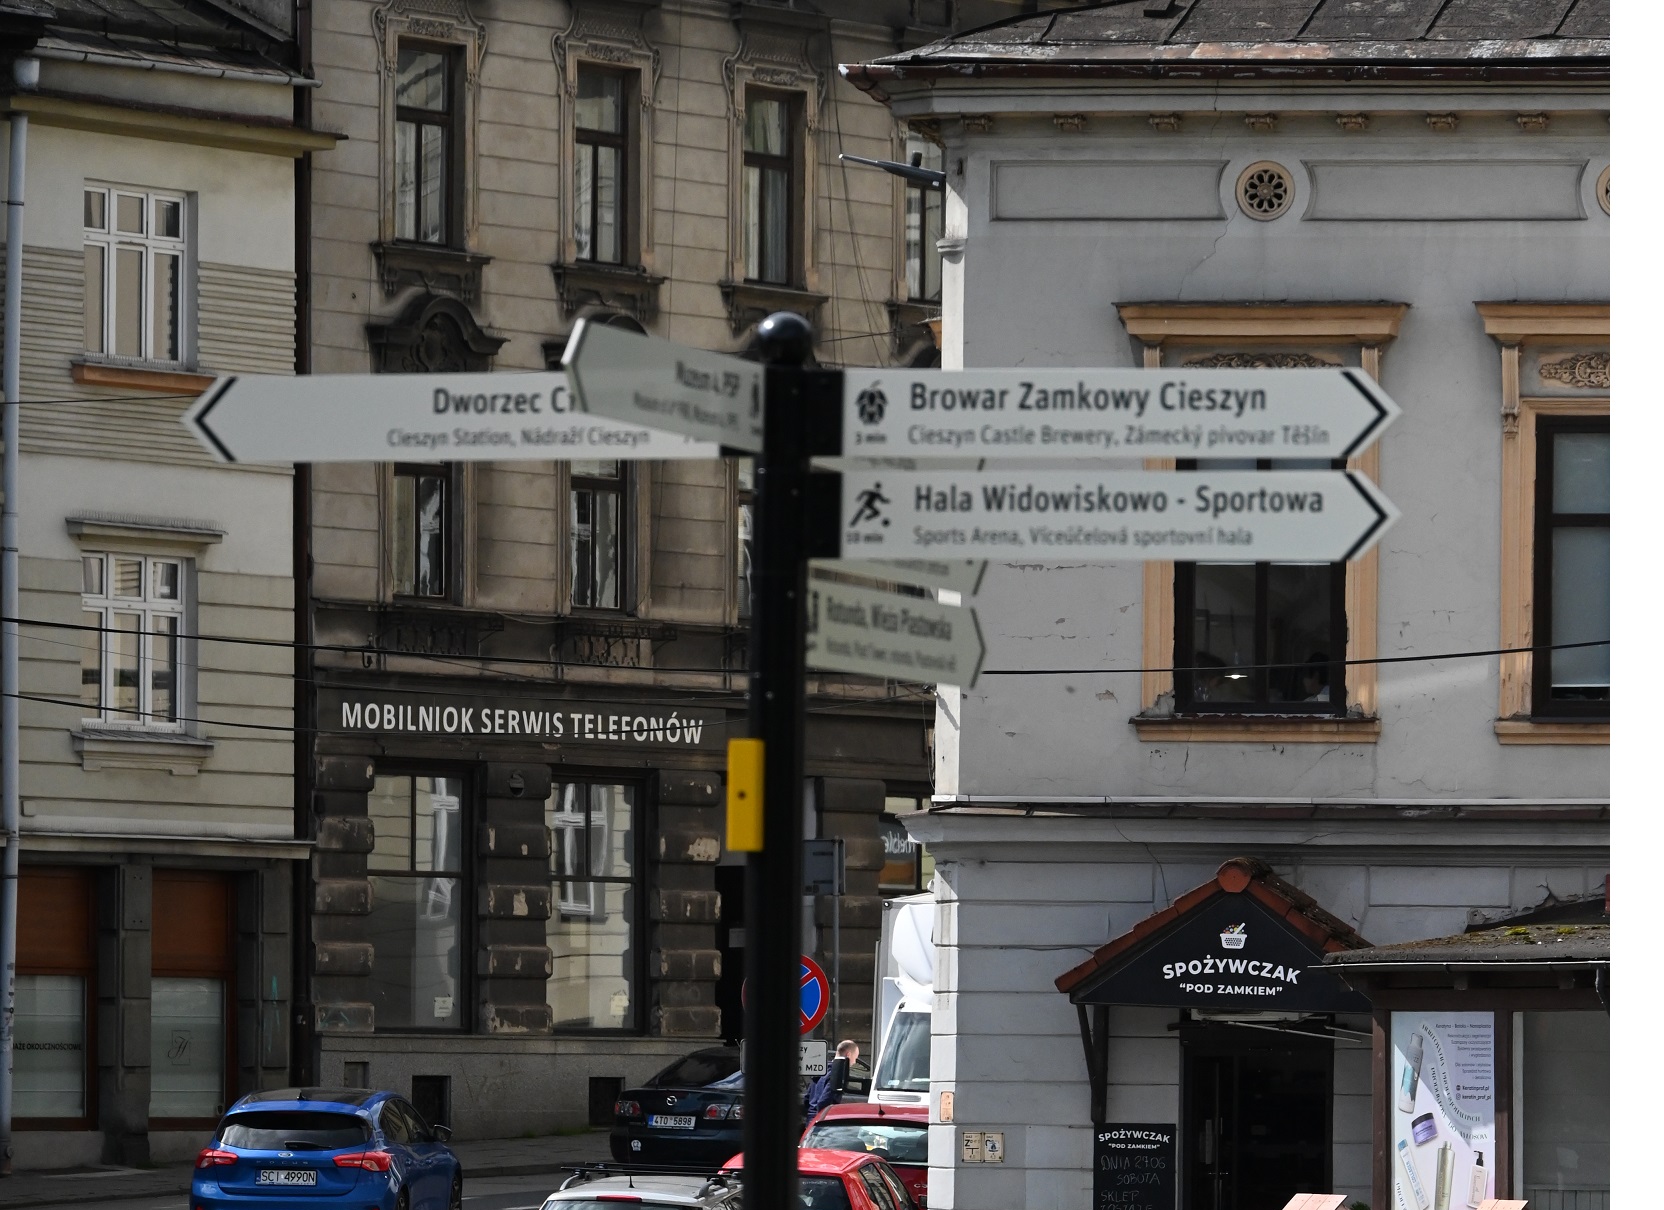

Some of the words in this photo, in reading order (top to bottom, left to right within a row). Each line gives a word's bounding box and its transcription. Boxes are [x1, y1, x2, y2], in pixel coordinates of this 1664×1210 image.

[432, 387, 542, 414] Dworzec
[910, 381, 1010, 411] Browar
[1017, 380, 1151, 418] Zamkowy
[1160, 381, 1267, 418] Cieszyn
[386, 427, 449, 451] Cieszyn
[453, 427, 517, 449] Station,
[520, 426, 584, 447] Nádraží
[587, 427, 650, 451] Cieszyn
[908, 425, 976, 449] Cieszyn
[980, 425, 1036, 445] Castle
[1040, 425, 1119, 449] Brewery,
[1124, 425, 1201, 448] Zámecký
[1207, 427, 1276, 449] pivovar
[1281, 425, 1331, 445] Těšín
[914, 484, 973, 512] Hala
[982, 484, 1168, 513] Widowiskowo
[1195, 484, 1324, 519] Sportowa
[913, 525, 967, 548] Sports
[972, 527, 1024, 547] Arena,
[1133, 526, 1214, 548] sportovní
[1217, 526, 1254, 546] hala
[341, 701, 474, 734] MOBILNIOK
[480, 708, 564, 738] SERWIS
[570, 711, 704, 745] TELEFONÓW
[1162, 954, 1301, 985] SPOŻYWCZAK
[1179, 983, 1214, 994] “POD
[1217, 984, 1283, 996] ZAMKIEM”
[805, 1064, 823, 1072] MZD
[1098, 1128, 1171, 1143] SPOŻYWCZAK
[261, 1171, 280, 1182] SCI
[284, 1171, 315, 1183] 4990N
[1116, 1172, 1161, 1186] SOBOTA
[1100, 1189, 1140, 1203] SKLEP
